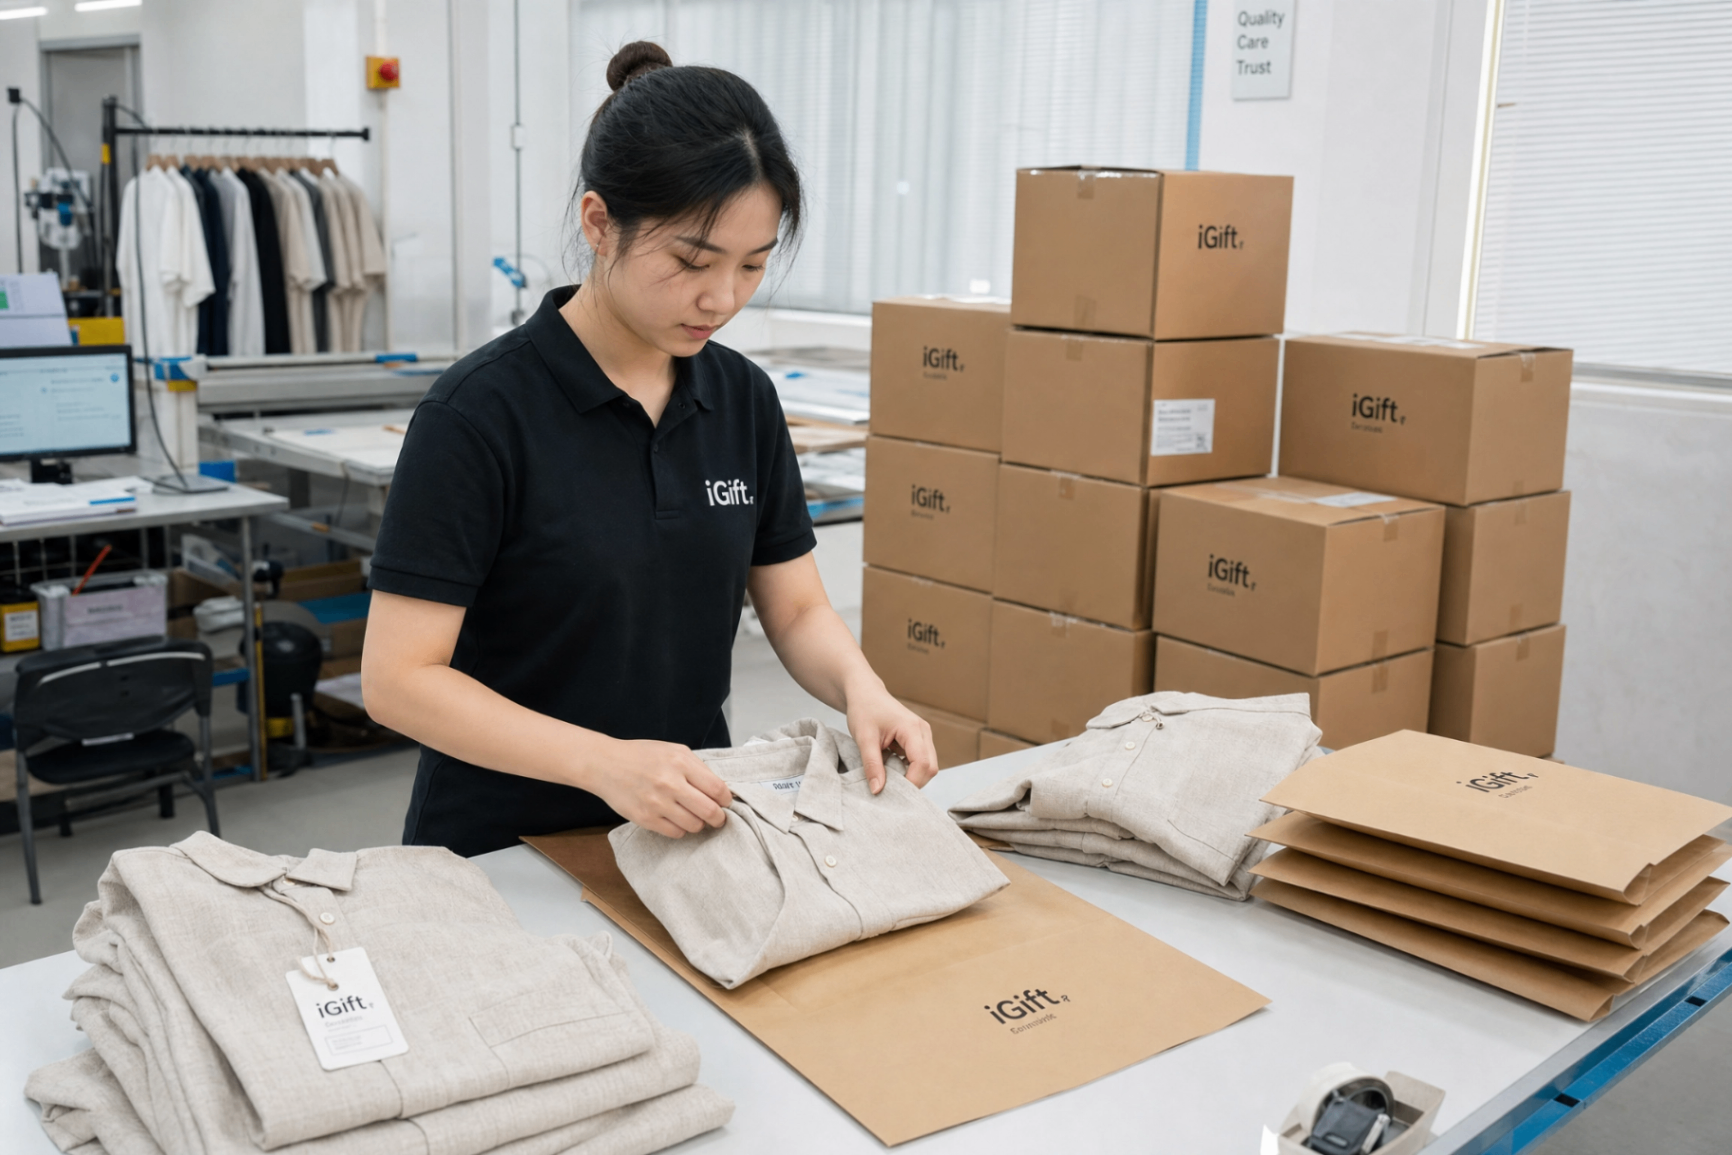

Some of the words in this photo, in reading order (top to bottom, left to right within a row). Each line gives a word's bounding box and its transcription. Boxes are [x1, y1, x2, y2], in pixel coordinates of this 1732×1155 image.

[1237, 9, 1286, 30] Quality
[1236, 33, 1269, 50] Care
[1236, 59, 1272, 76] Trust
